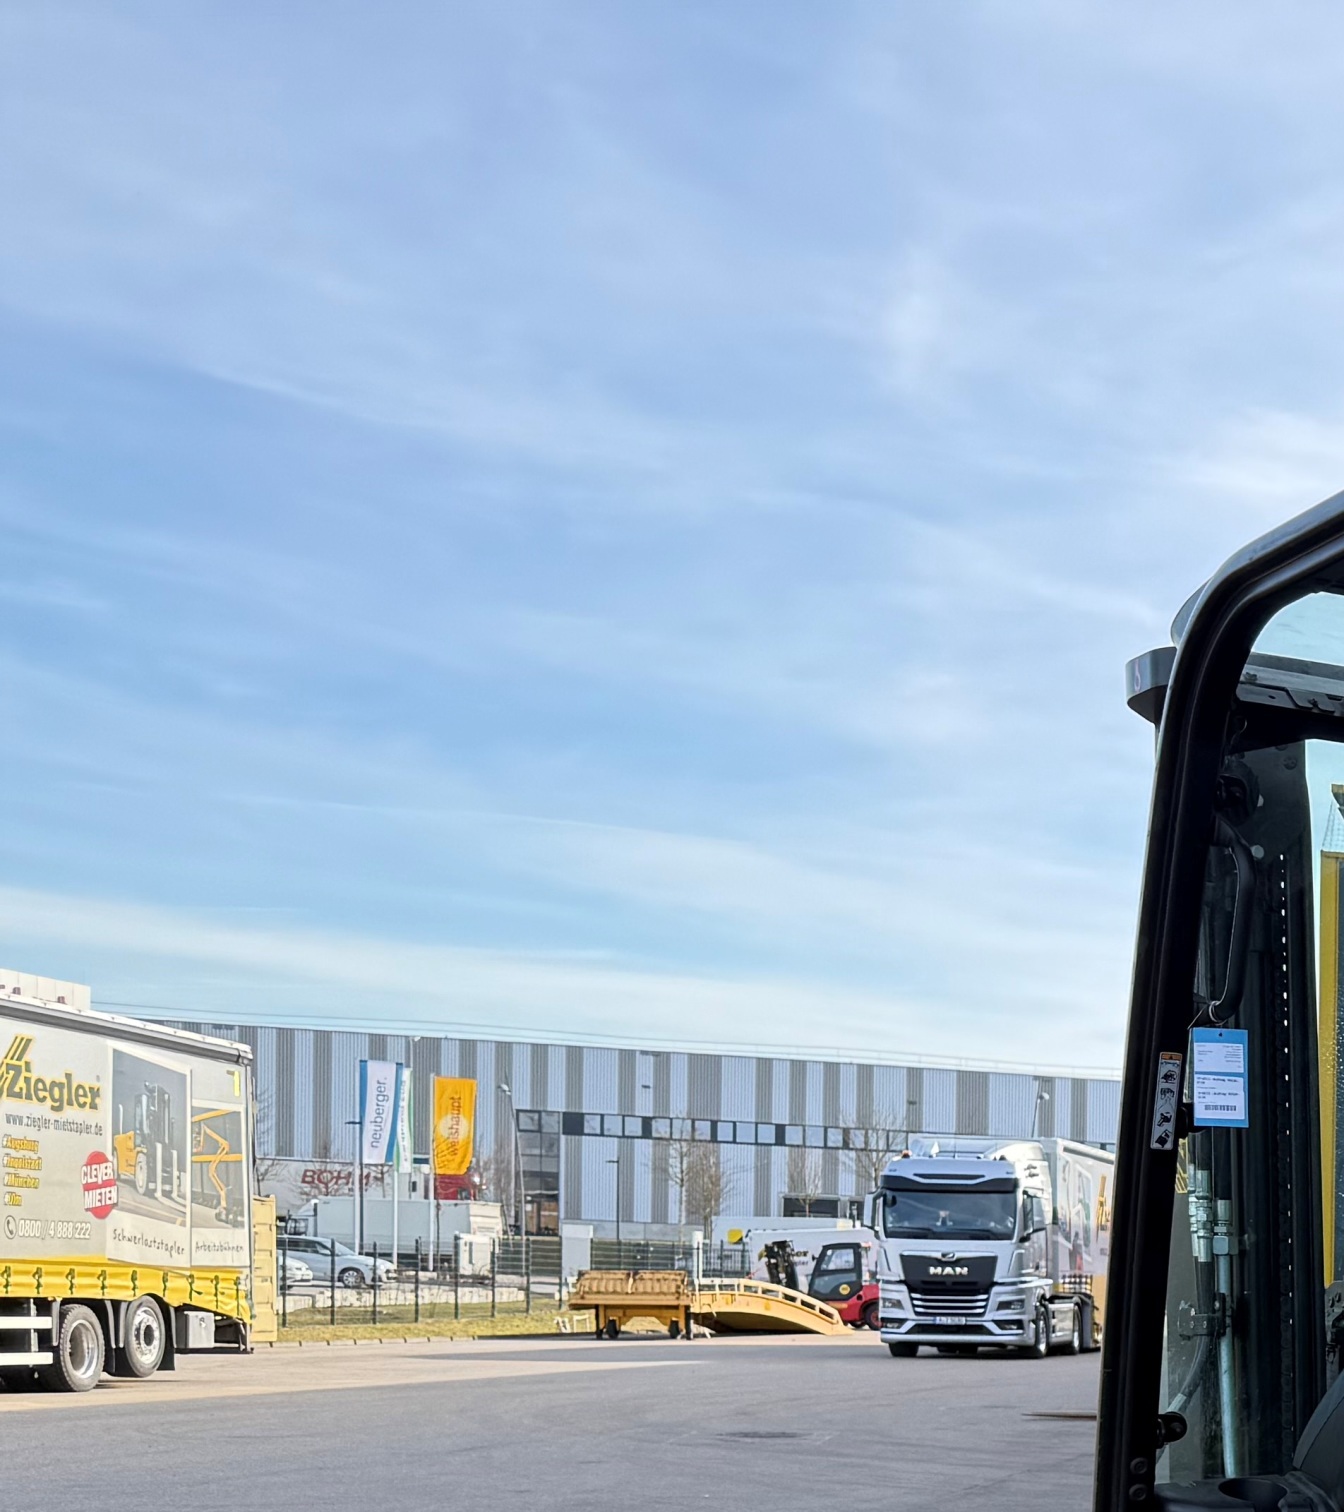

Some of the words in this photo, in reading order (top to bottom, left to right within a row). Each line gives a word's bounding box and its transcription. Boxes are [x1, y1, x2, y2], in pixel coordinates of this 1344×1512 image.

[4, 1060, 101, 1113] Ziegler
[5, 1113, 103, 1137] www.ziegler-mietstapler.de
[371, 1077, 388, 1149] neuberger.
[82, 1162, 114, 1185] CLEVER
[84, 1186, 119, 1211] MIETEN
[18, 1219, 41, 1238] 0800
[48, 1220, 56, 1238] 4
[56, 1220, 74, 1239] 888
[74, 1221, 91, 1240] 222
[113, 1228, 184, 1258] Schwerlaststapler
[929, 1266, 968, 1275] MAN
